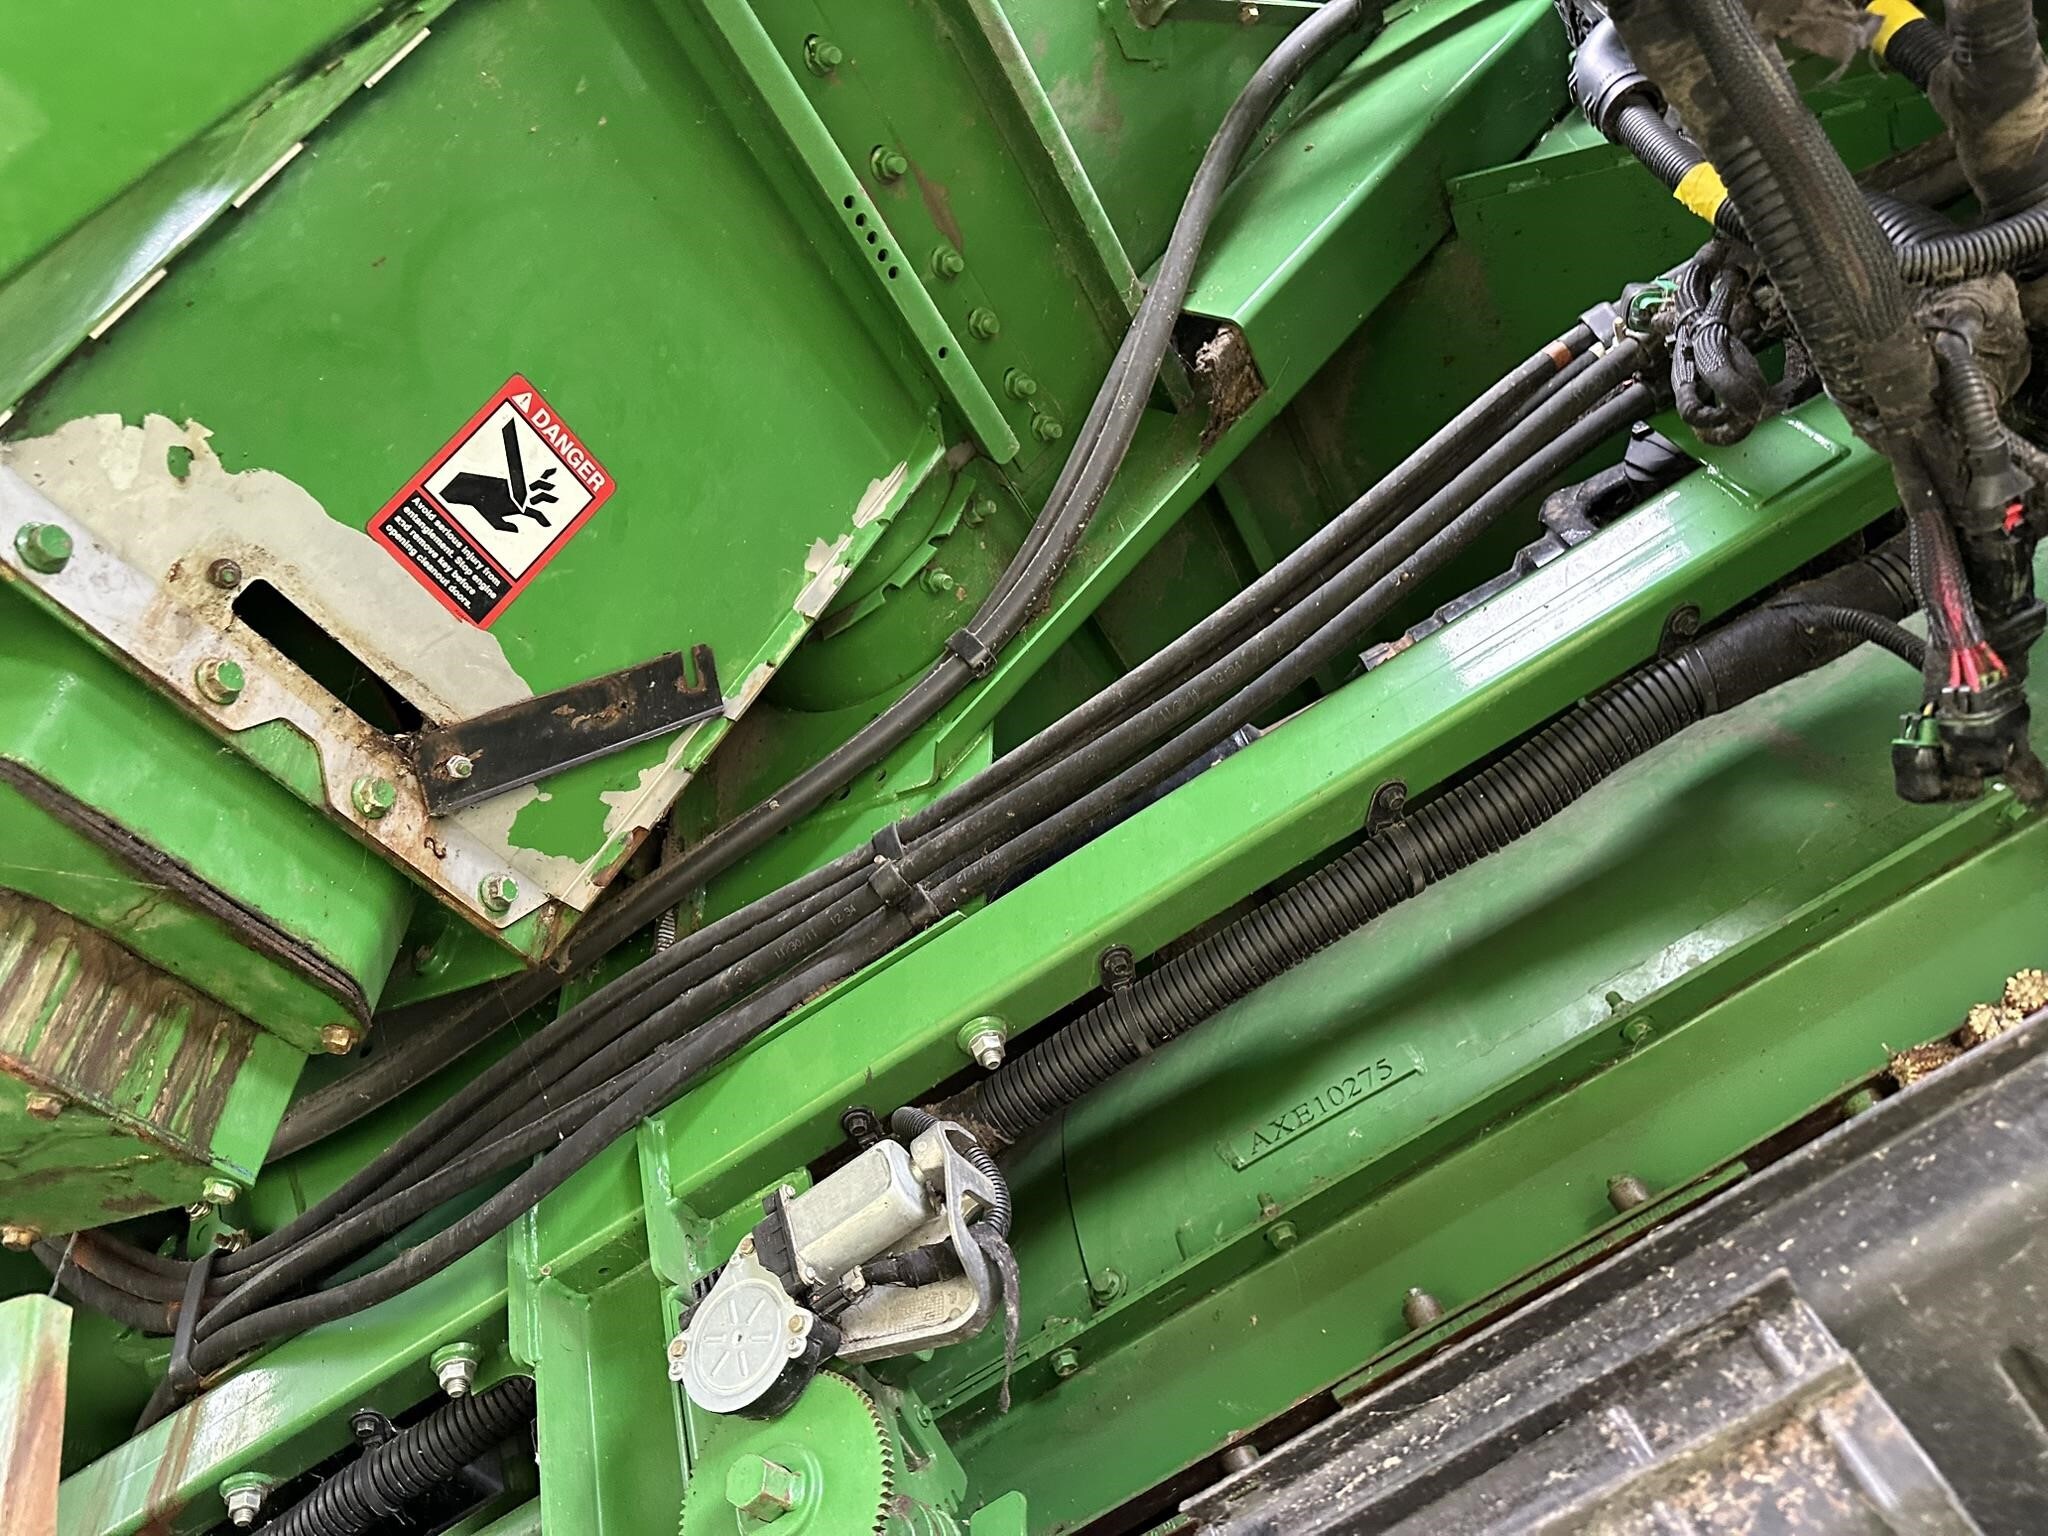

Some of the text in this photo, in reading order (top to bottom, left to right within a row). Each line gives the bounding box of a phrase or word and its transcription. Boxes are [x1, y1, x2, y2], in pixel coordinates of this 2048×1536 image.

[531, 408, 604, 491] DANGER
[385, 524, 470, 609] opening cleanout doors.
[394, 515, 475, 594] and remove key before
[403, 506, 496, 598] entanglement. Stop engine
[411, 497, 500, 586] Avoid serious injury from
[1250, 1058, 1394, 1156] AXE10275
